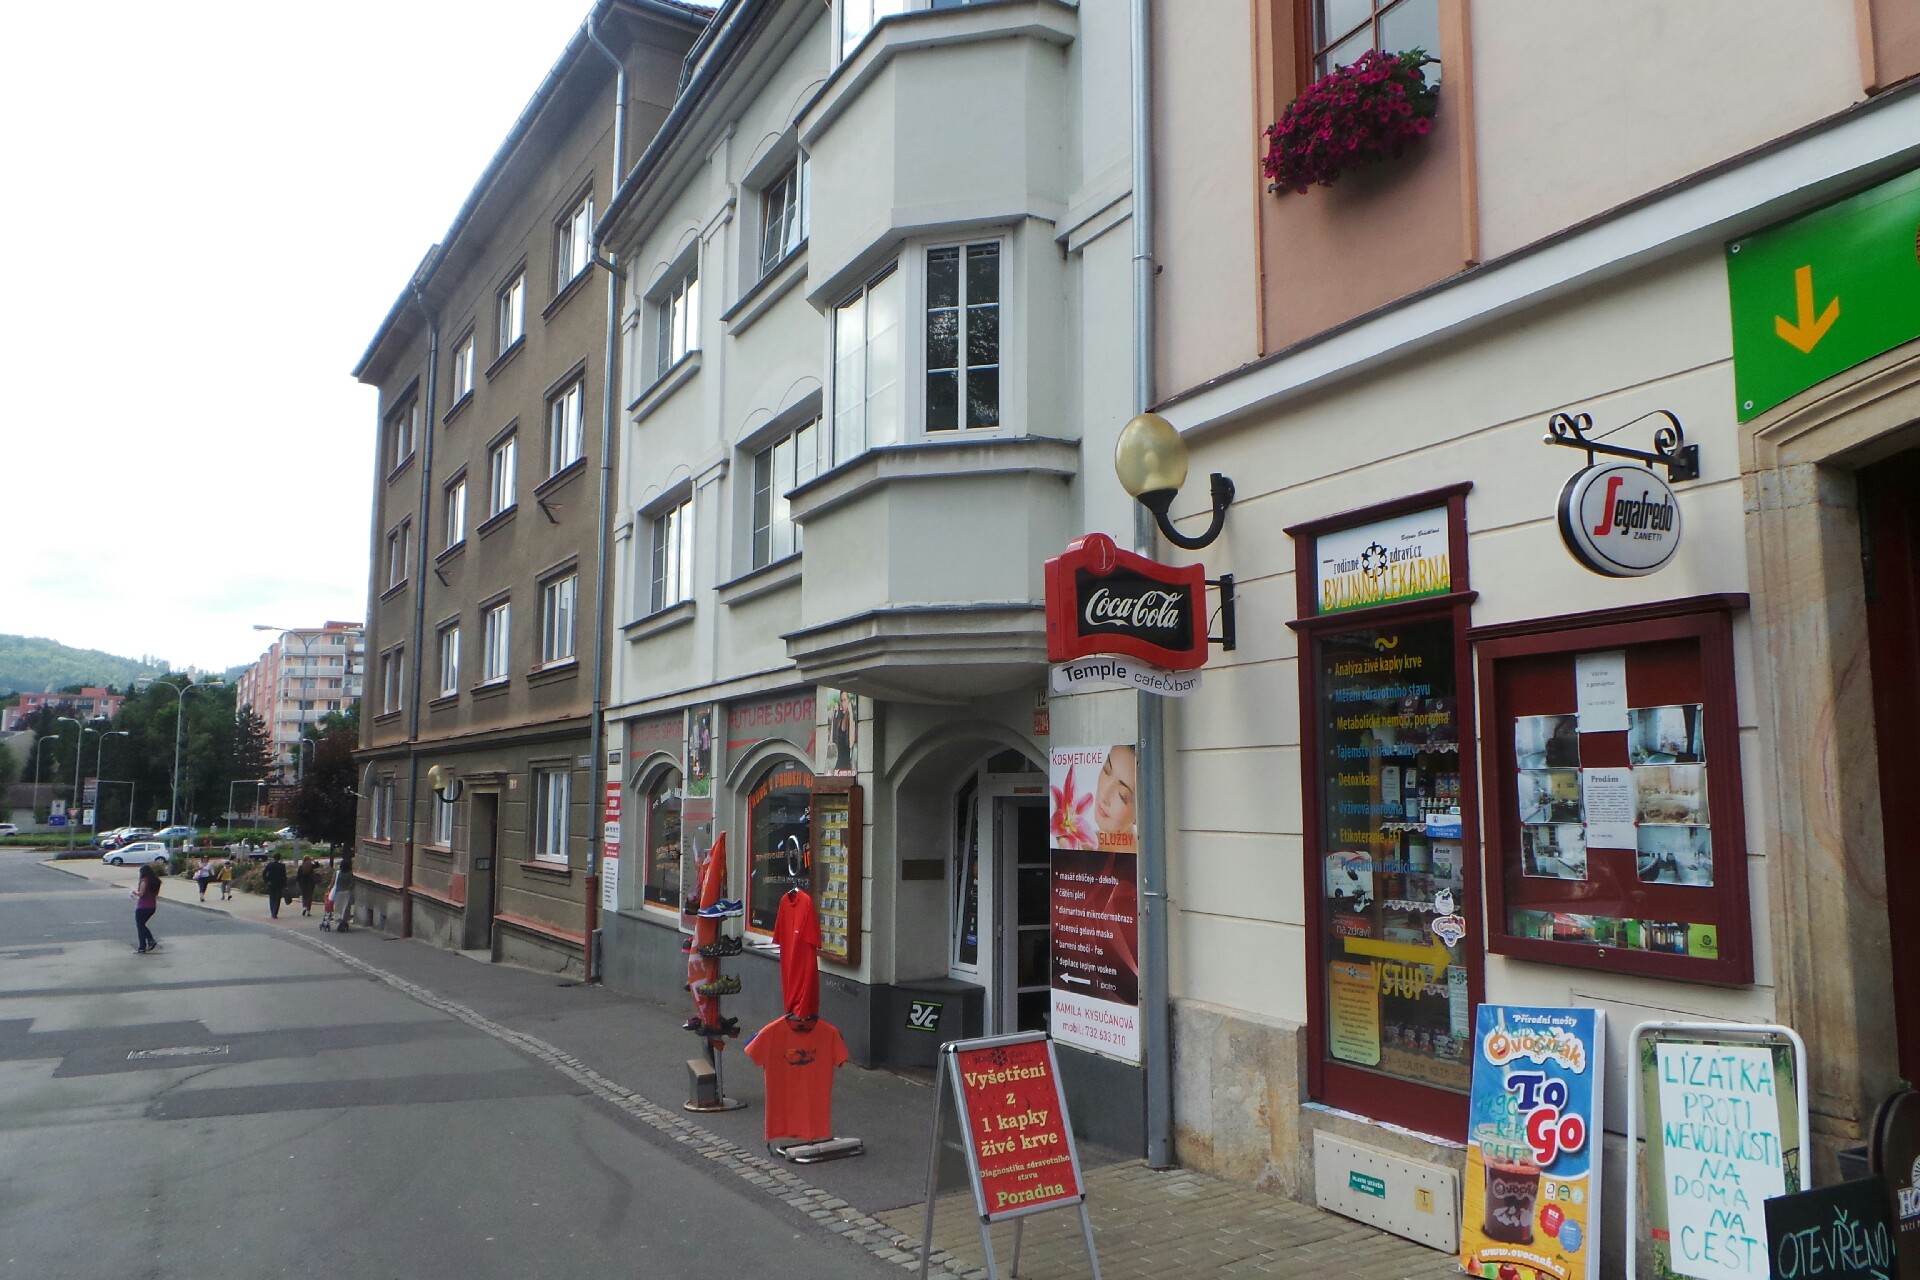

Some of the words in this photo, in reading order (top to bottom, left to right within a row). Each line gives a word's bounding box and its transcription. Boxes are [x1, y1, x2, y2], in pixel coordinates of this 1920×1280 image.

[1593, 476, 1674, 536] Segafredo
[1633, 531, 1663, 541] ZANETTI
[1333, 557, 1359, 574] rodinné
[1085, 587, 1183, 628] Coca-Cola
[1062, 661, 1127, 683] Temple
[1134, 672, 1197, 692] cafe&bar
[1334, 661, 1362, 678] Analýza
[1364, 657, 1379, 673] živé
[1380, 655, 1403, 674] kapky
[1404, 654, 1422, 669] krve
[1362, 683, 1407, 701] zdravotního
[1408, 683, 1431, 696] stavu
[727, 704, 772, 729] FUTURE
[1337, 714, 1380, 731] Metabolické
[1052, 749, 1103, 766] KOSMETICKÉ
[1591, 775, 1619, 783] Prodám
[1100, 830, 1134, 846] SLUŽBY
[1059, 905, 1086, 918] diamantová
[1086, 910, 1133, 923] mikrodermabraze
[1096, 929, 1114, 939] maska
[1059, 957, 1078, 968] depilace
[1097, 964, 1117, 976] voskem
[1100, 982, 1117, 991] patro
[1370, 961, 1425, 1000] VSTUP
[1055, 1001, 1082, 1018] KAMILA
[1085, 1008, 1134, 1030] KYSUČANOVÁ
[1512, 1014, 1551, 1024] Přírodní
[1552, 1016, 1578, 1027] mošty
[1085, 1025, 1098, 1039] 732
[1113, 1034, 1126, 1046] 210
[965, 1061, 1047, 1090] Vyšetření
[1006, 1092, 1016, 1105] z
[1507, 1075, 1566, 1111] To
[982, 1117, 992, 1133] 1
[996, 1109, 1048, 1131] kapky
[1683, 1092, 1752, 1130] PROTI
[981, 1136, 1016, 1157] živé
[1020, 1132, 1059, 1151] krve
[1527, 1108, 1584, 1163] Go
[1664, 1121, 1781, 1168] NEVOLNOSTI
[979, 1162, 1025, 1179] Diagnostika
[1026, 1154, 1071, 1169] zdravotního
[1017, 1172, 1039, 1182] stavu
[1699, 1158, 1741, 1184] NA
[996, 1182, 1065, 1207] Poradna
[1674, 1175, 1750, 1211] DOMA
[1709, 1209, 1747, 1233] NA
[1680, 1225, 1768, 1274] CEST
[1777, 1204, 1889, 1280] OTEVŘENO
